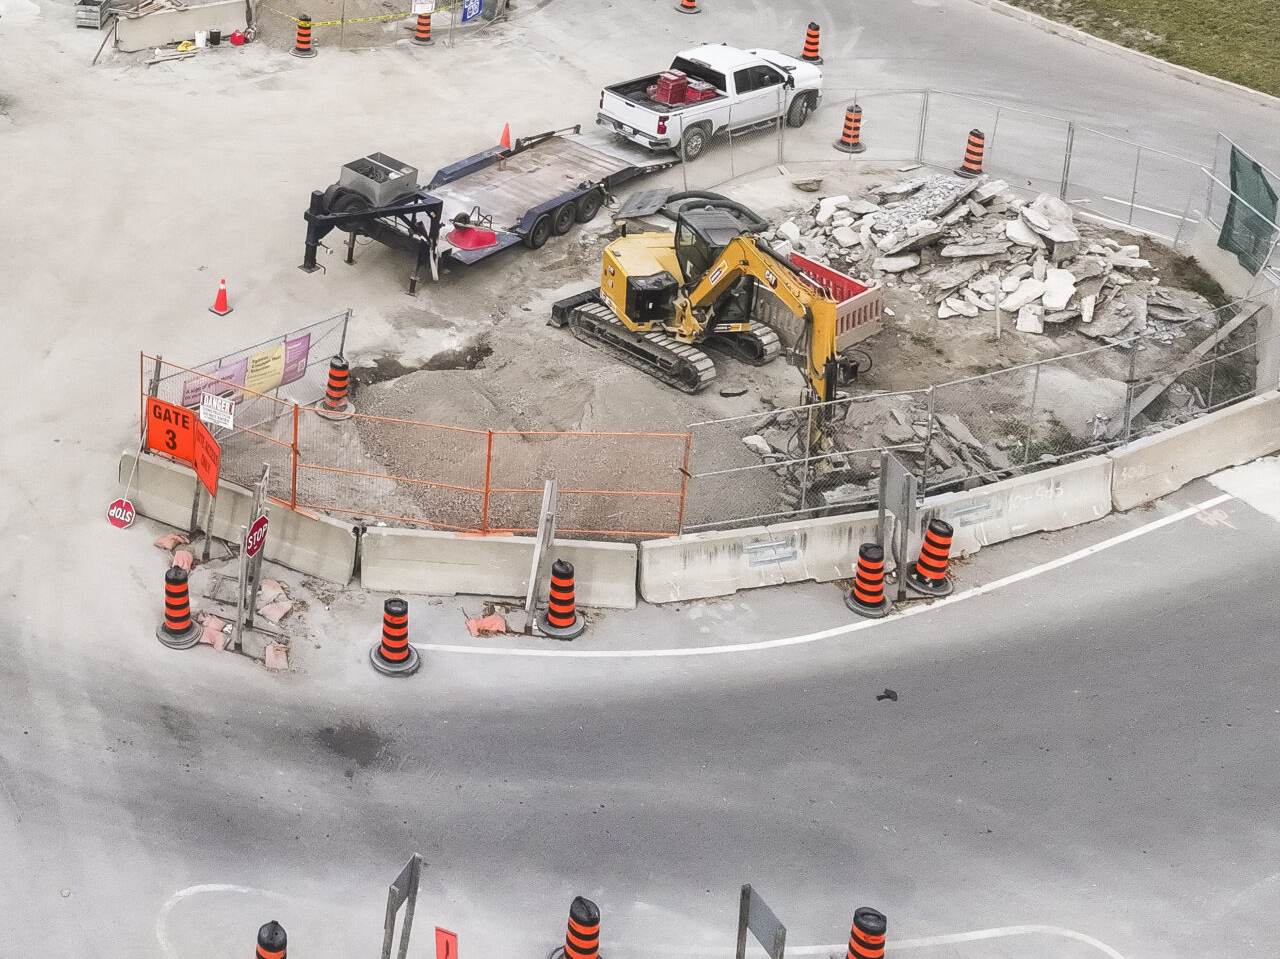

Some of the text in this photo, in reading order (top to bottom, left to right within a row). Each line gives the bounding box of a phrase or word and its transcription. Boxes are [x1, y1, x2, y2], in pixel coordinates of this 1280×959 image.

[765, 269, 777, 285] CAT
[204, 394, 230, 412] DANGER
[153, 405, 190, 430] GATE
[165, 429, 177, 450] 3
[109, 507, 133, 522] STOP
[247, 524, 268, 549] STOP
